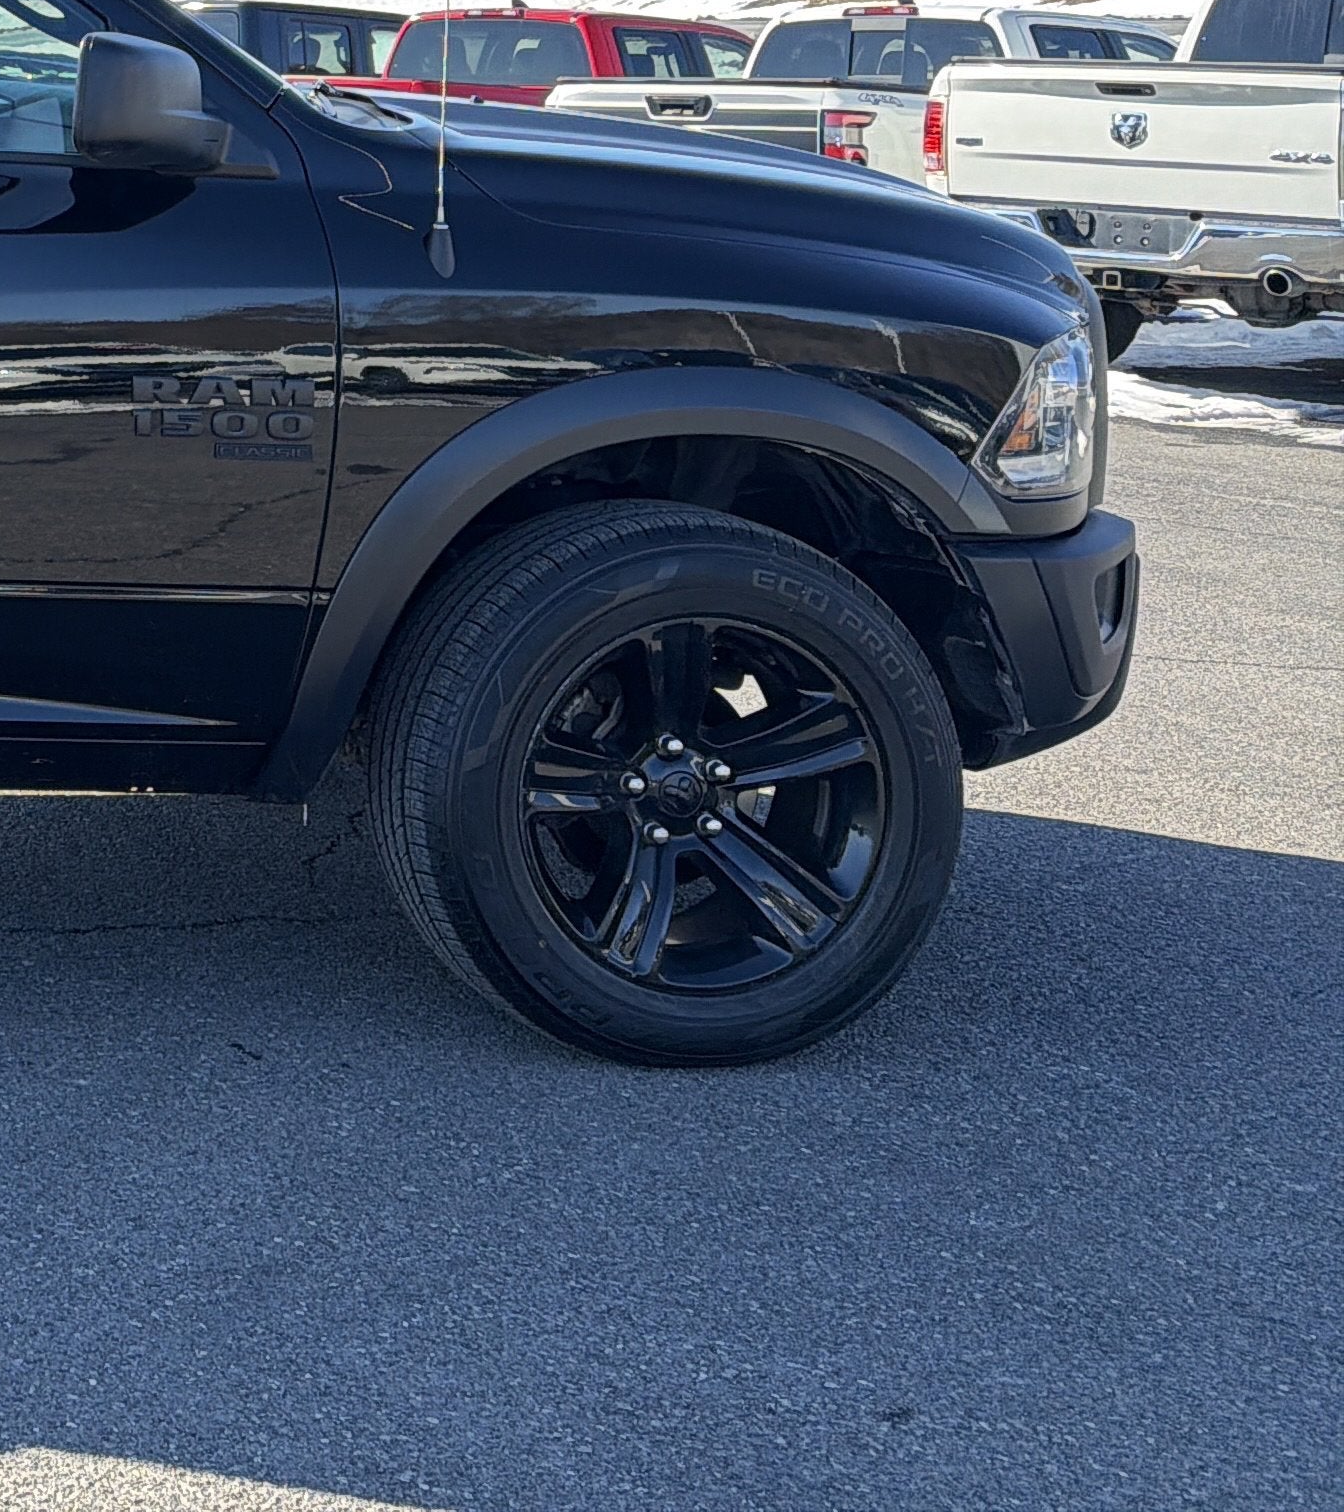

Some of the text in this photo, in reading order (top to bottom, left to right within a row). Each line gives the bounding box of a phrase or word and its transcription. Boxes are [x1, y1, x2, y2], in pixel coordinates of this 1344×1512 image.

[131, 375, 315, 407] RAM
[133, 408, 315, 442] 1500
[217, 445, 309, 458] CLASSIC
[752, 568, 830, 613] ECO
[837, 606, 905, 681] PRO
